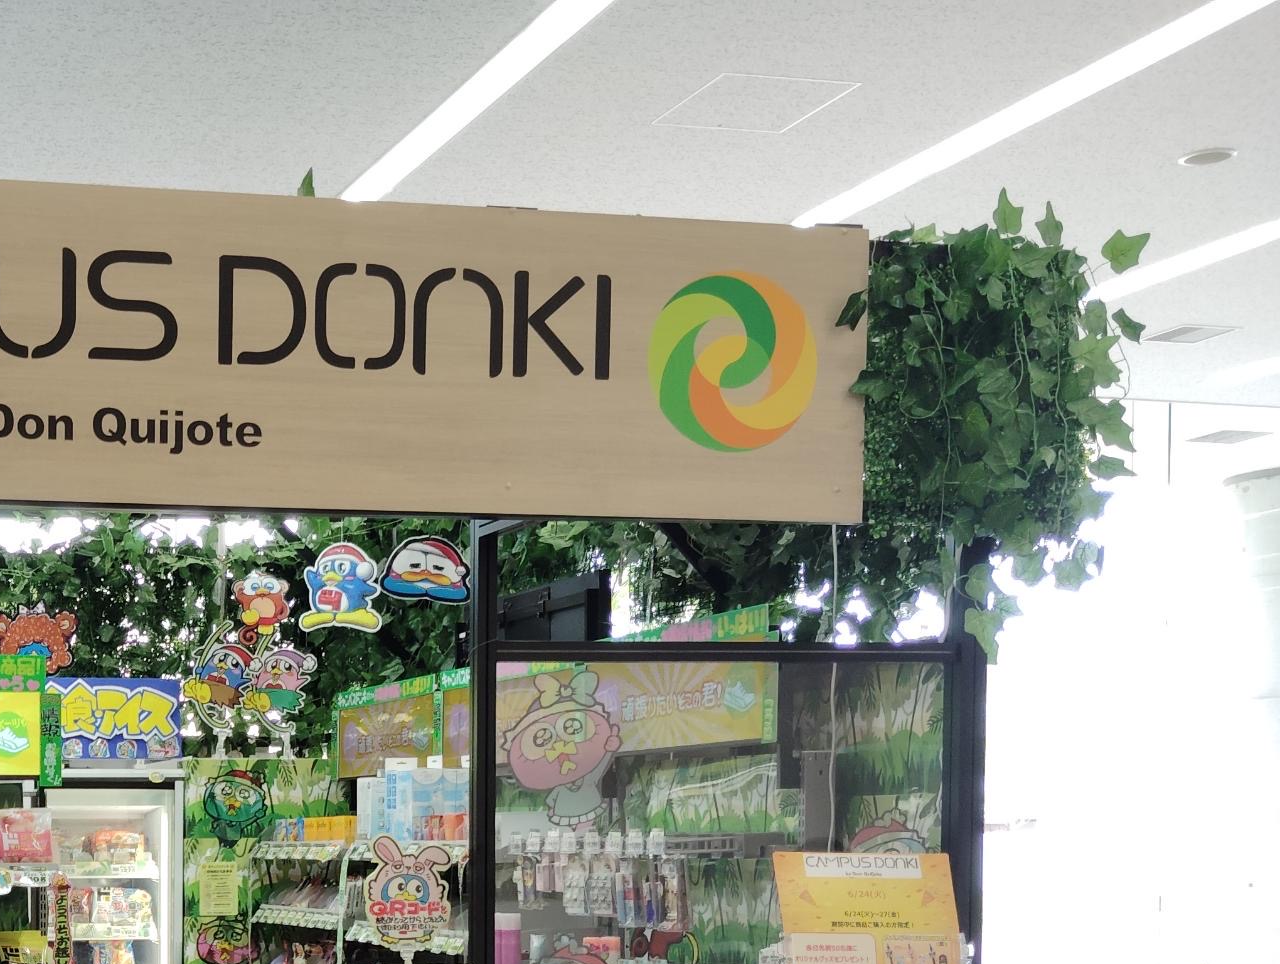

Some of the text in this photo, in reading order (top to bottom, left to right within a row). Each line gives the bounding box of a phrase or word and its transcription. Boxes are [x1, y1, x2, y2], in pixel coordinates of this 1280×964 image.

[219, 254, 612, 381] DONKI
[92, 405, 264, 456] Quijote
[805, 856, 919, 870] CAMPUS DONKI
